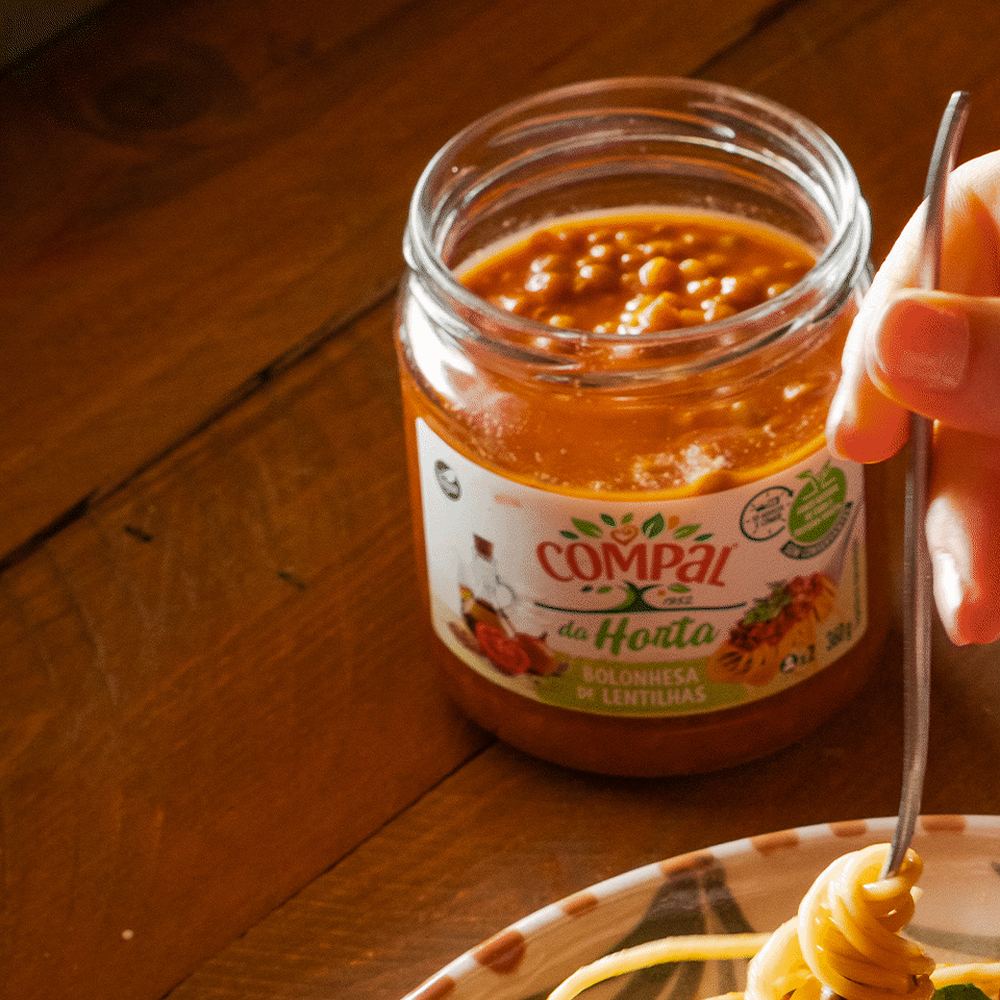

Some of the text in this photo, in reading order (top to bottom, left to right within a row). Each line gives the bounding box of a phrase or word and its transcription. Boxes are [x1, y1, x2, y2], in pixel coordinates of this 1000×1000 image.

[558, 617, 717, 655] da Horta
[582, 665, 700, 686] BOLONHESA
[602, 685, 707, 706] LENTILHAS
